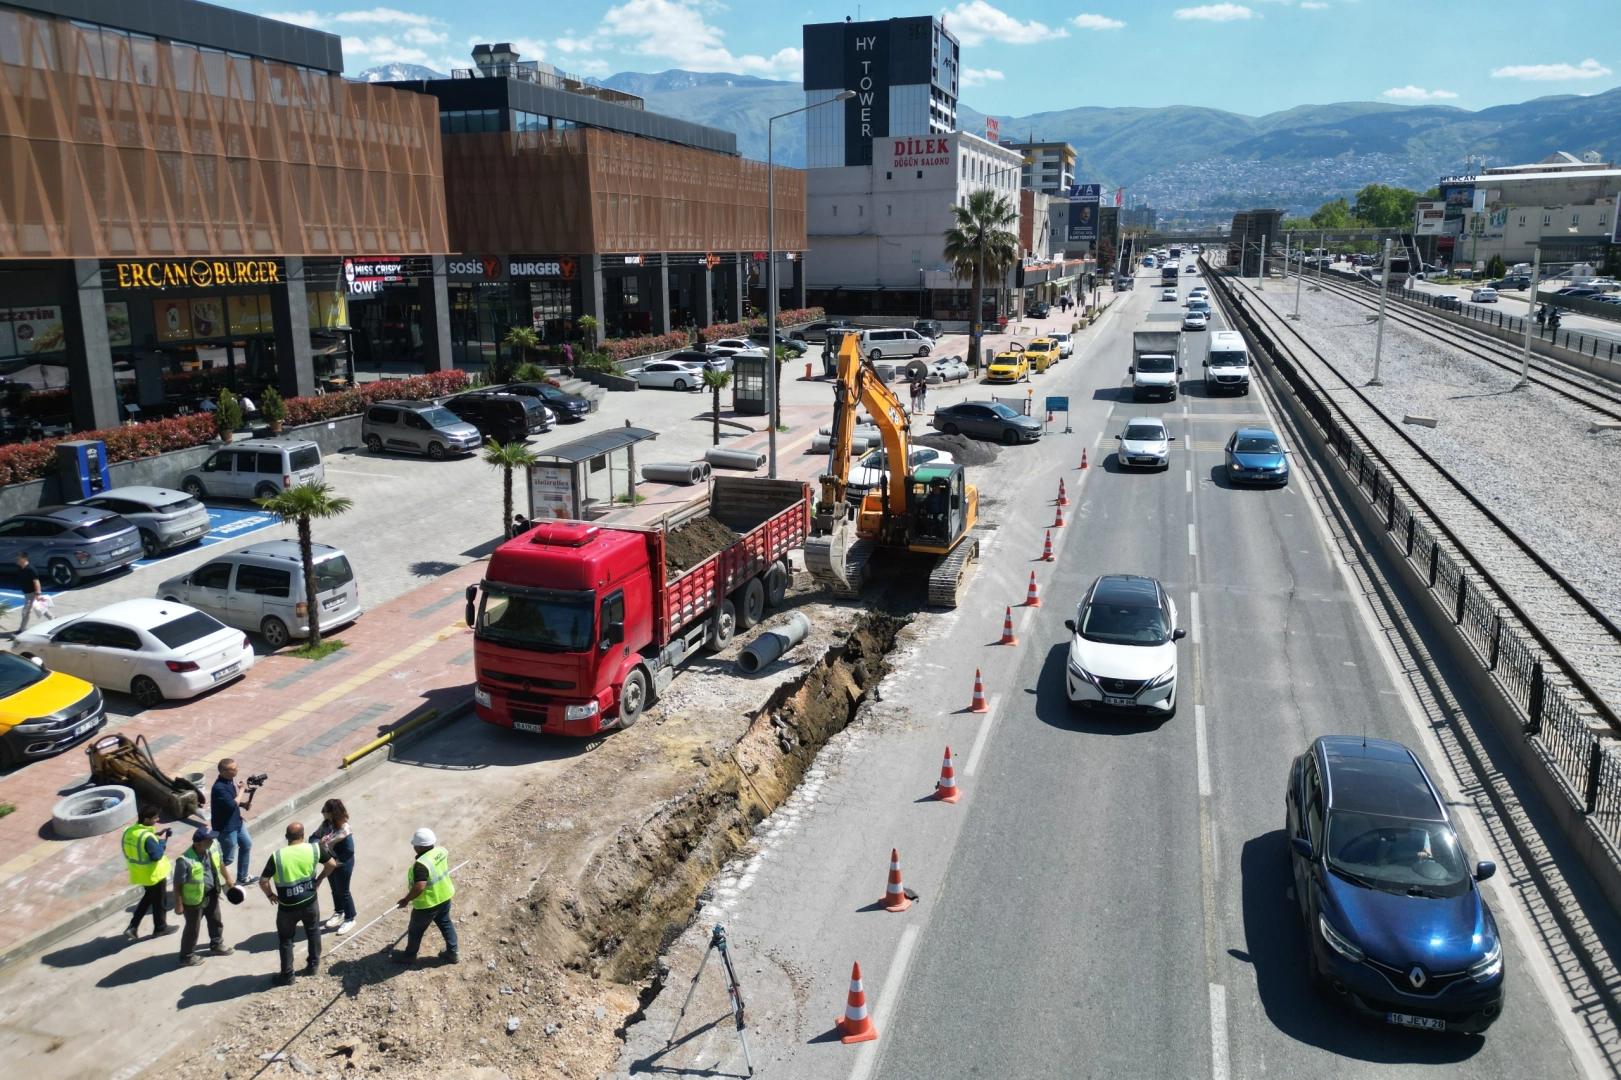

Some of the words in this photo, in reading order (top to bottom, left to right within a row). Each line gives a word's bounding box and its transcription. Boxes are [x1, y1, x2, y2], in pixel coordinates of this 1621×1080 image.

[856, 36, 876, 51] HY
[858, 61, 875, 137] TOWER
[894, 137, 950, 156] DİLEK
[894, 157, 919, 168] DÜĞÜN
[921, 156, 950, 166] SALONU
[117, 263, 189, 288] ERCAN
[213, 261, 280, 284] BURGER
[355, 265, 374, 275] MISS
[375, 264, 402, 275] CRISPY
[510, 262, 561, 276] BURGER
[348, 281, 385, 293] TOWER
[1392, 1013, 1403, 1023] 16
[1406, 1016, 1428, 1026] JEV
[1431, 1020, 1445, 1029] 28
